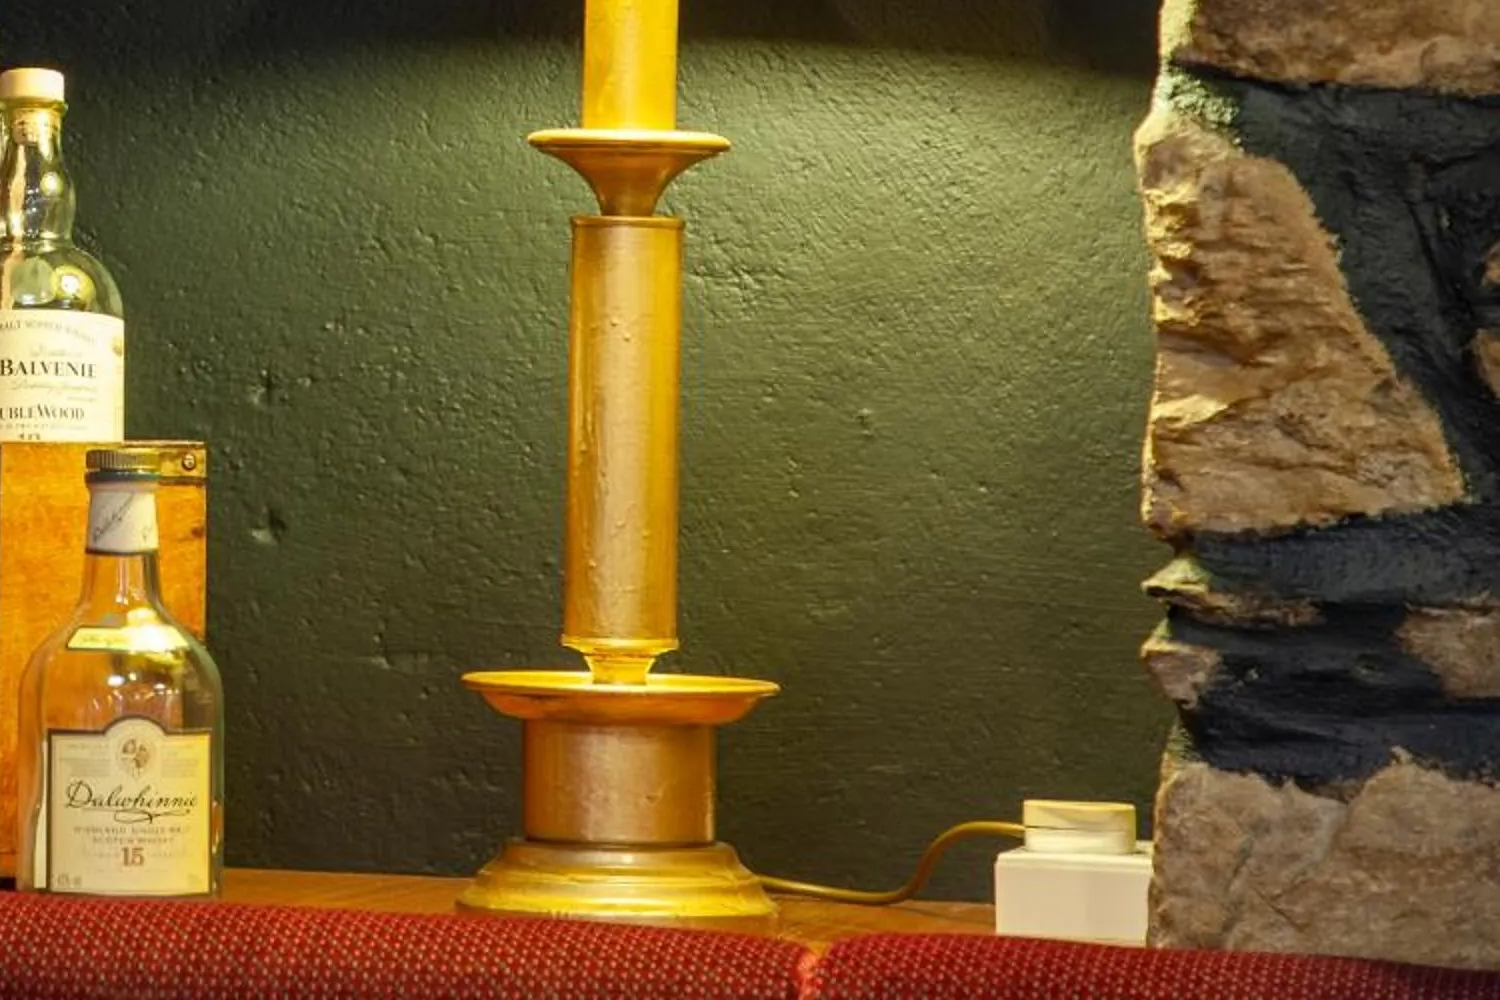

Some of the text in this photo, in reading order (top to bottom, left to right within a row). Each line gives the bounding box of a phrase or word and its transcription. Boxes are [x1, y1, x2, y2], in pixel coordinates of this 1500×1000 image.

[0, 358, 97, 379] BALVENIE
[65, 780, 198, 810] Dalwhinnie
[120, 847, 144, 867] 15
